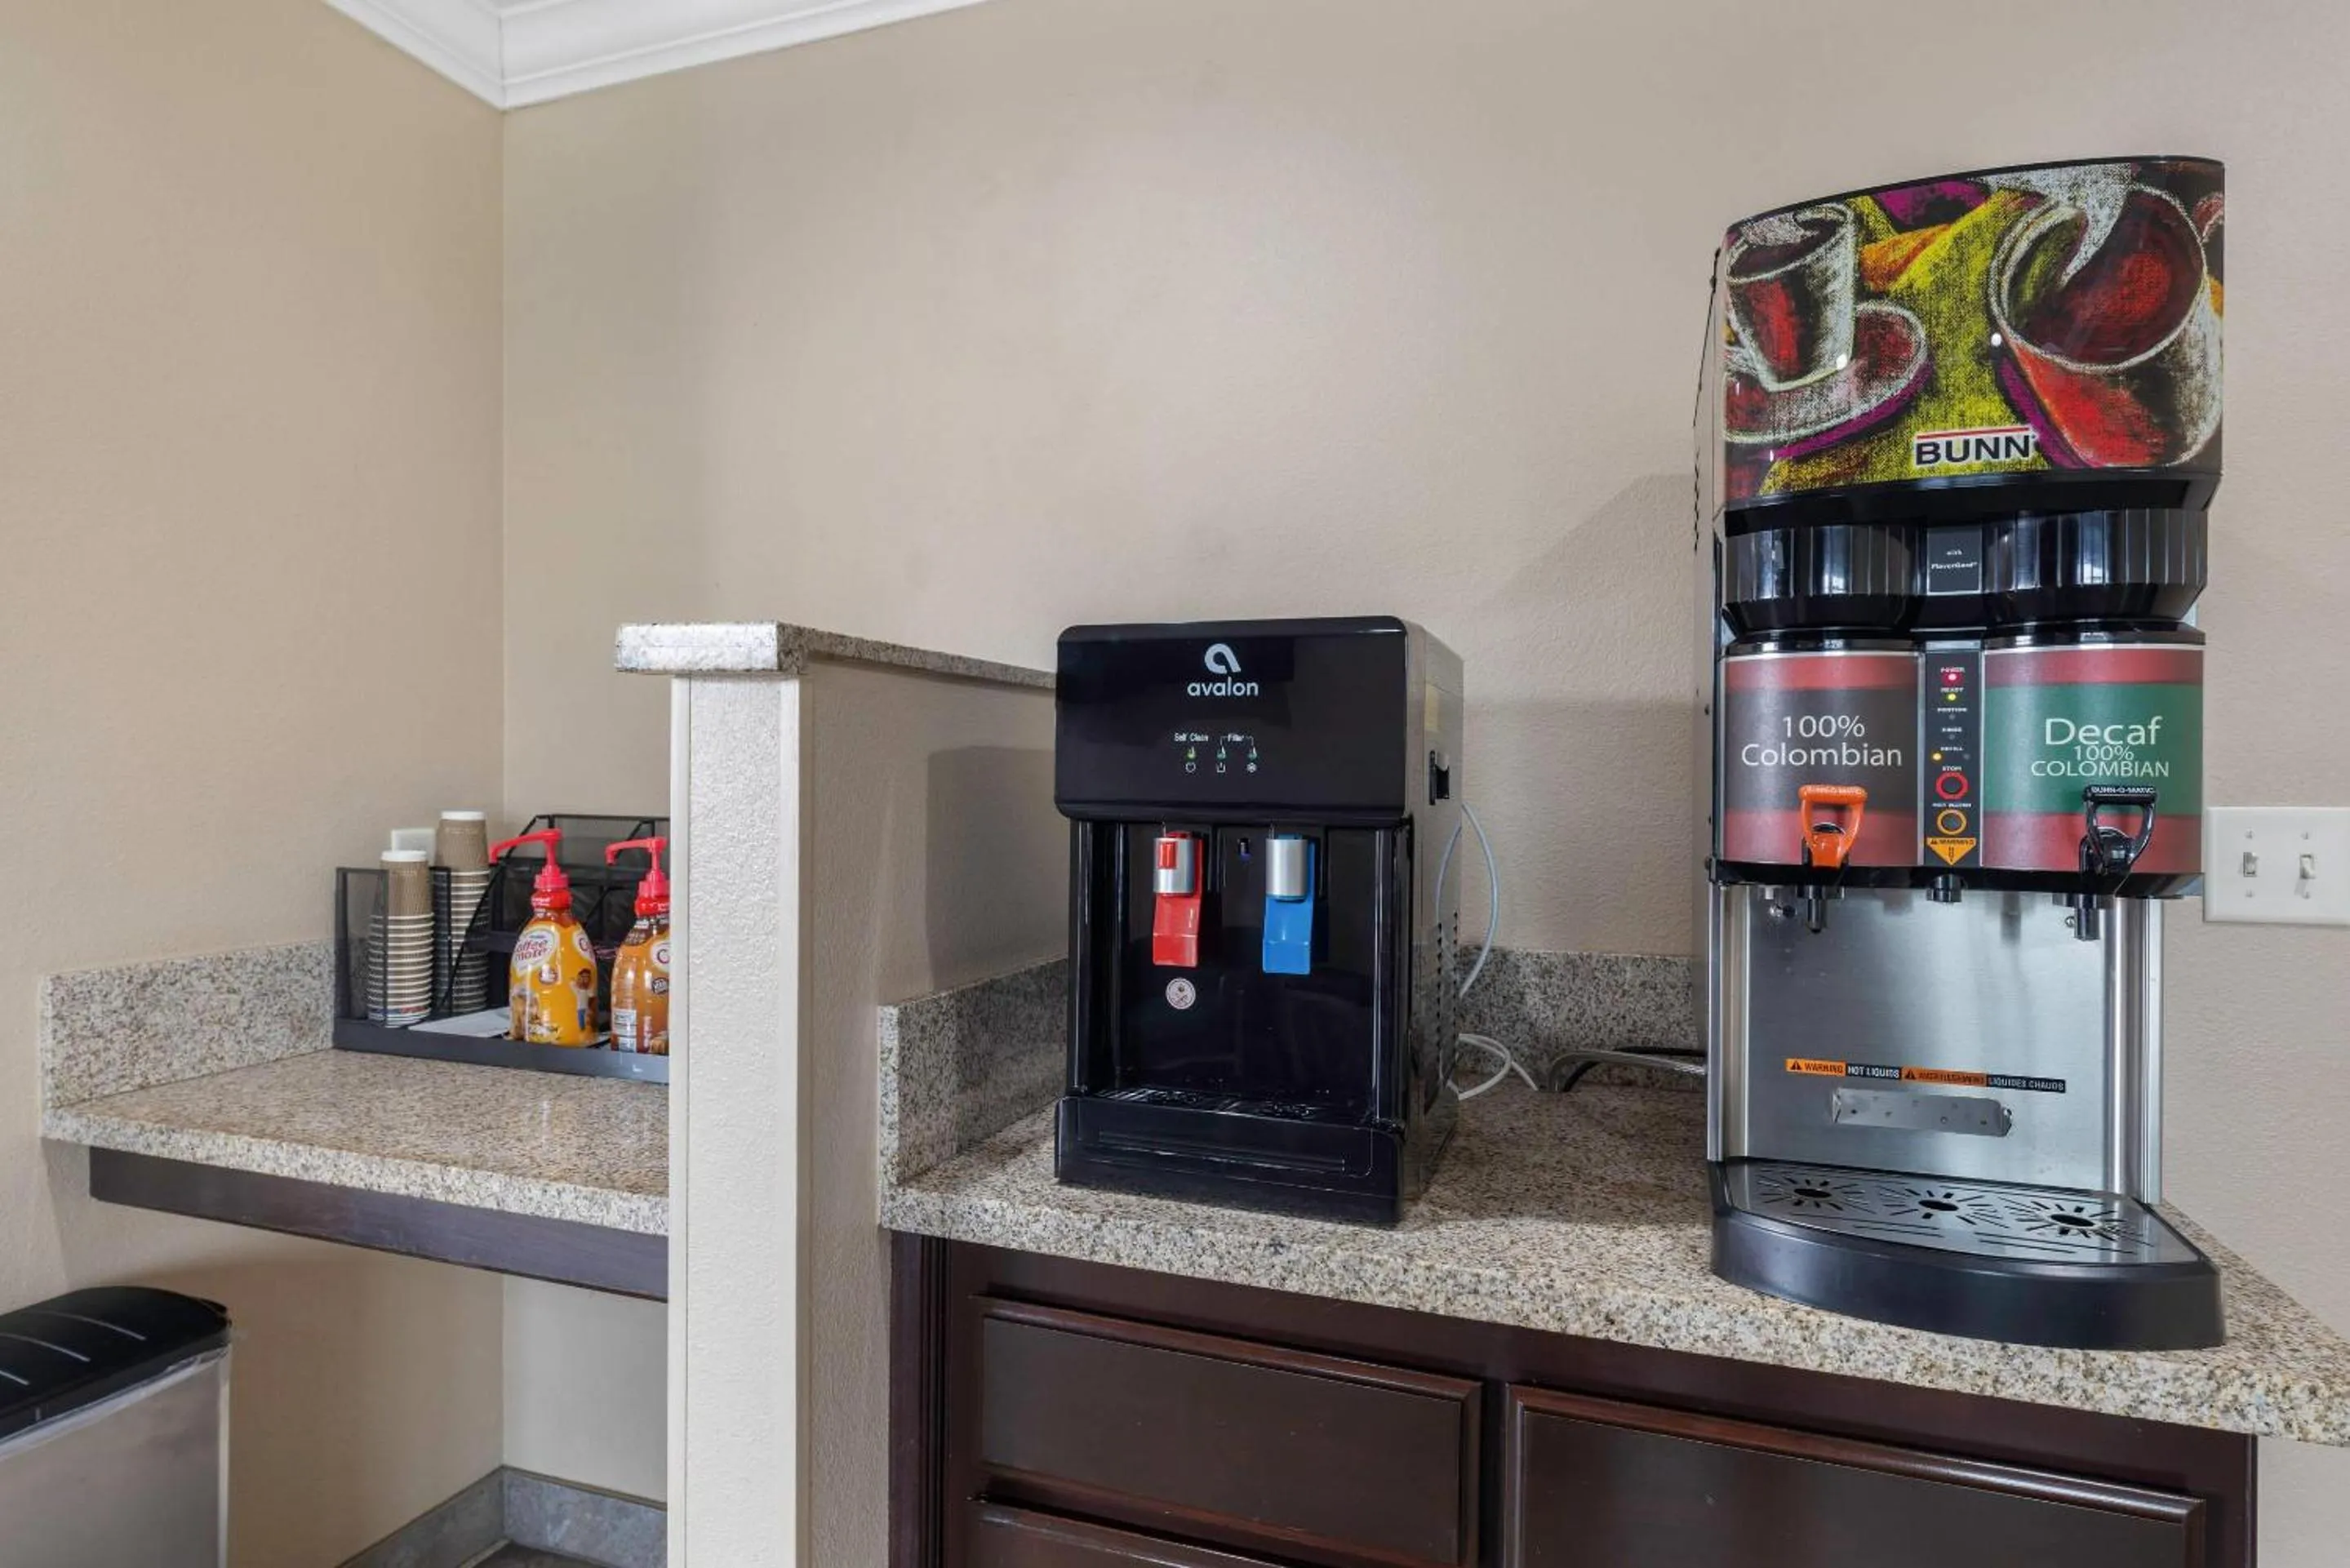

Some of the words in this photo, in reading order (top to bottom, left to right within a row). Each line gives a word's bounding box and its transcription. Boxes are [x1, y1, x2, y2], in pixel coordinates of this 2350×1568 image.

[1916, 434, 2030, 466] BUNN
[1187, 676, 1259, 697] avalon
[1782, 715, 1866, 739] 100%
[2045, 715, 2164, 746] Decaf
[1741, 741, 1903, 766] Colombian
[2073, 744, 2135, 762] 100%
[2031, 760, 2170, 778] COLOMBIAN
[1804, 1061, 1844, 1075] WARNING
[1848, 1066, 1864, 1076] HOT
[1866, 1067, 1900, 1078] LIQUIDS
[1989, 1076, 2027, 1089] LIQUIDES
[2028, 1080, 2065, 1092] CHAUDS
